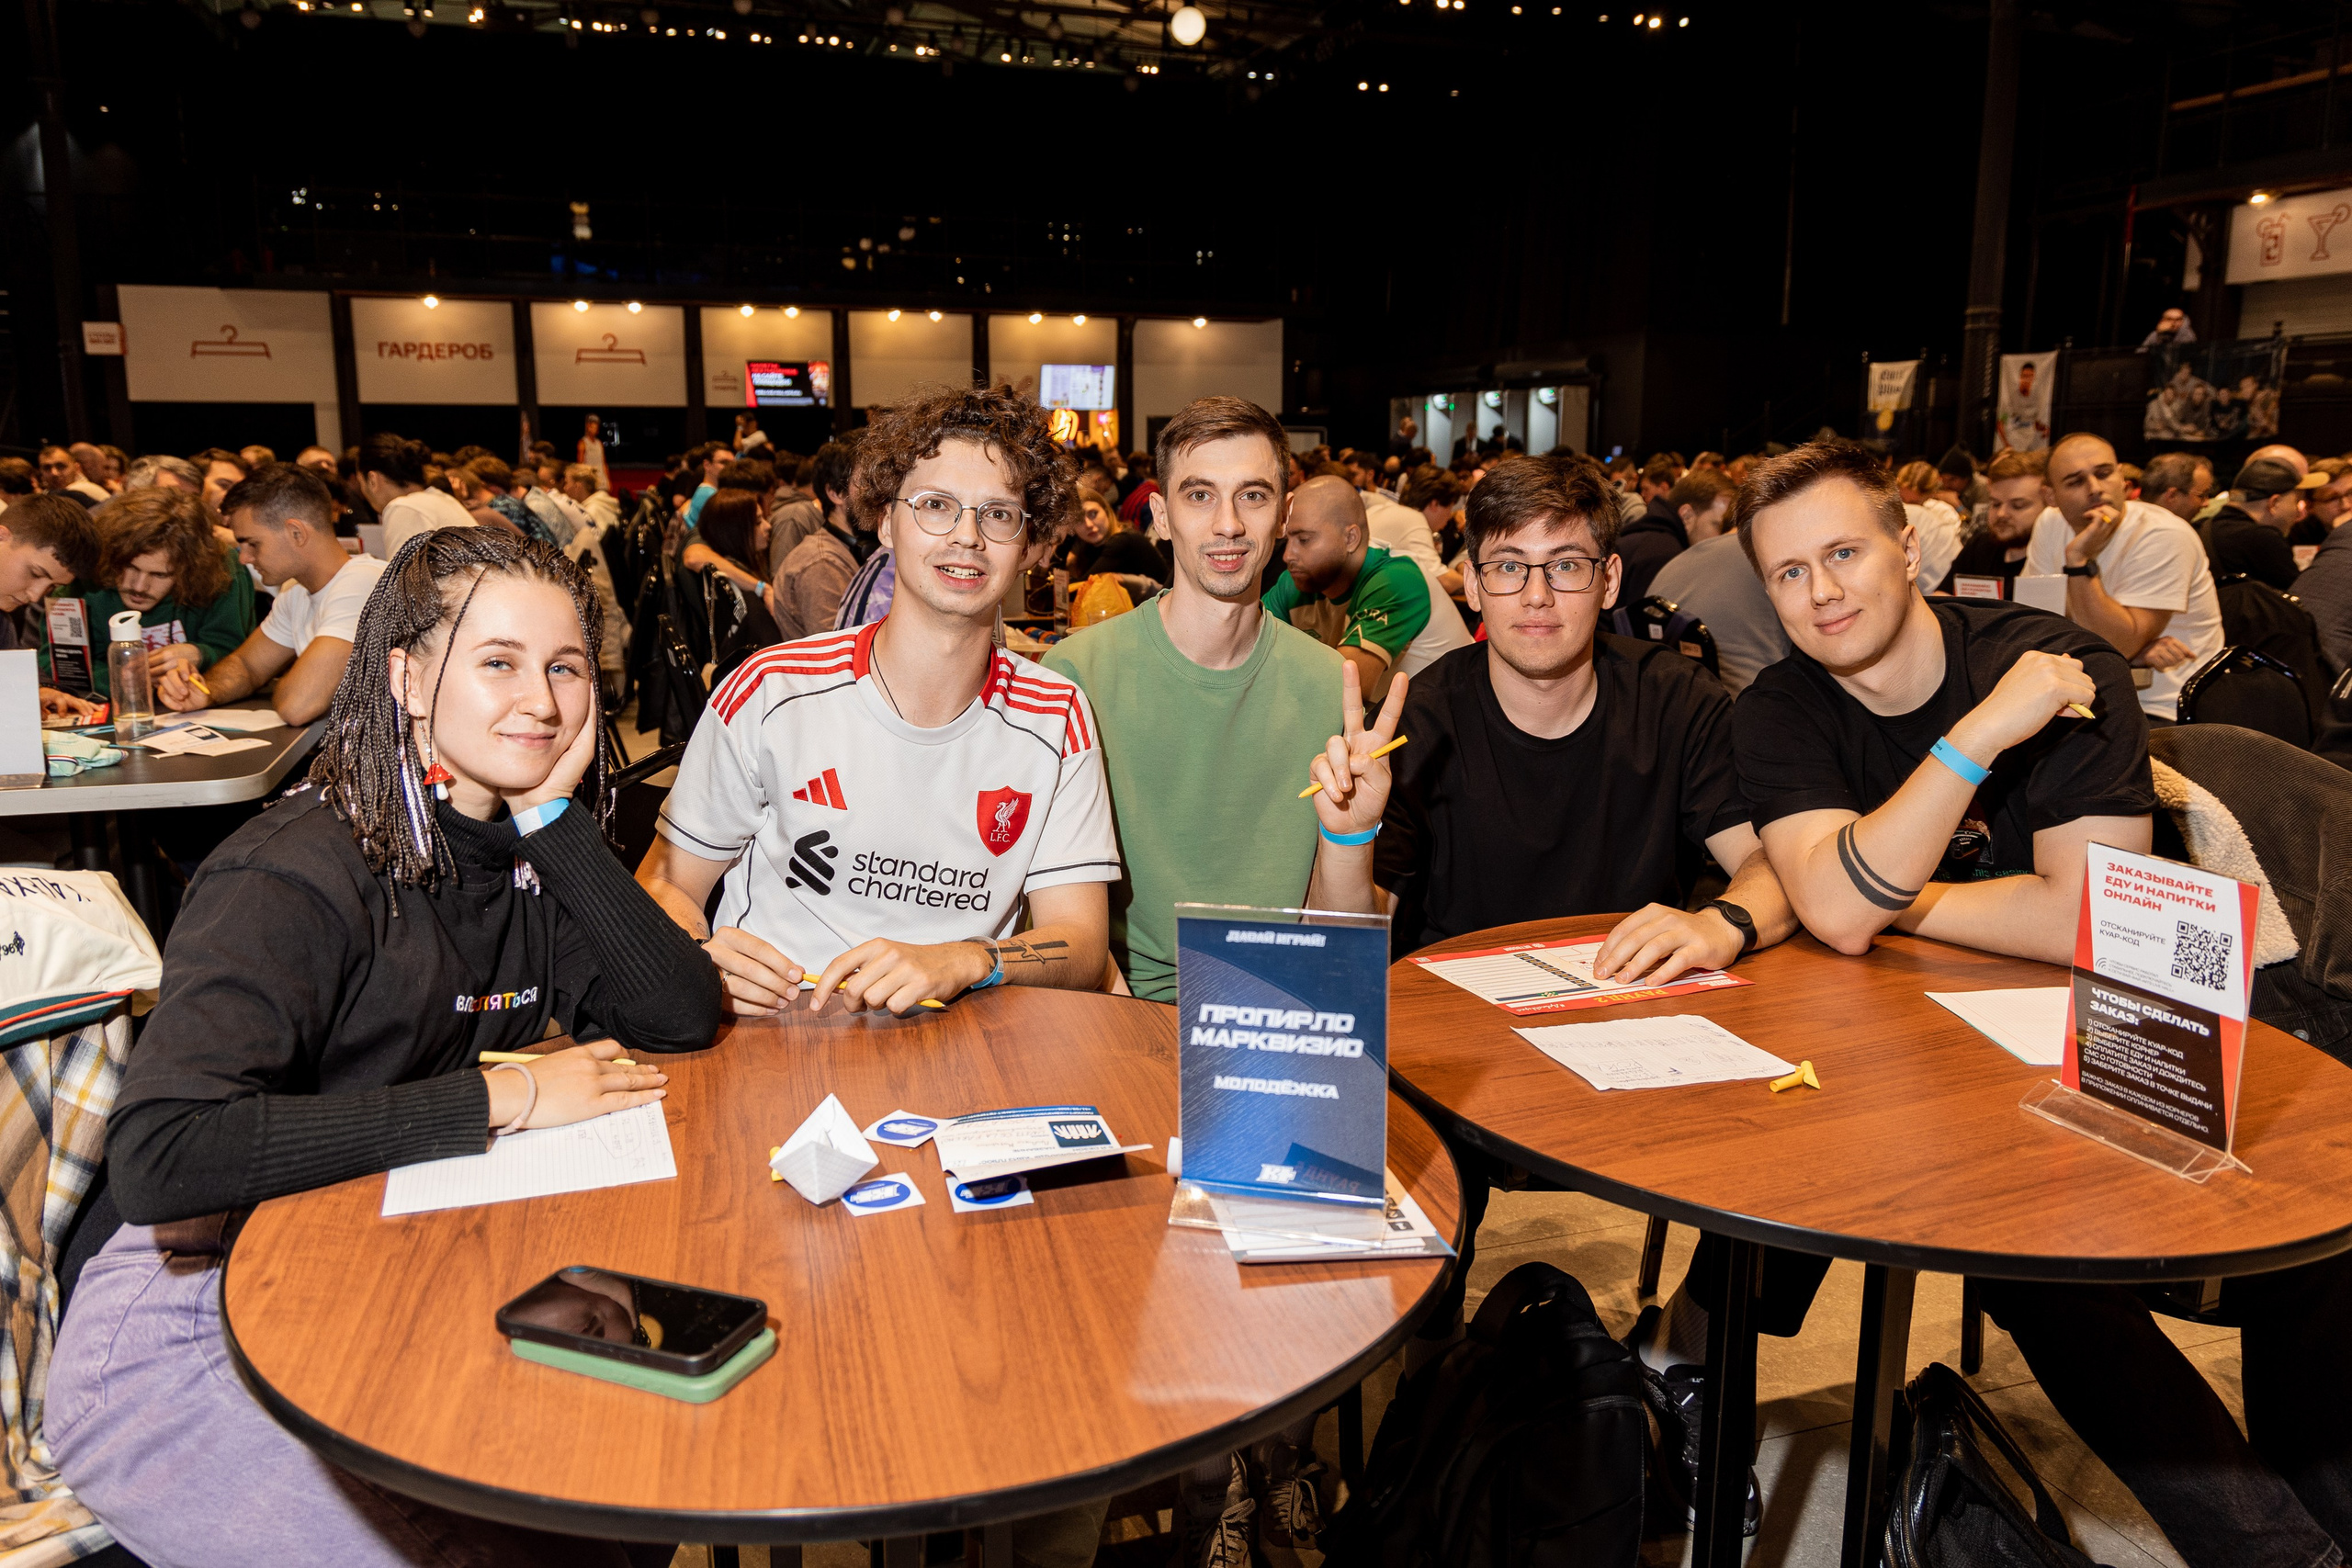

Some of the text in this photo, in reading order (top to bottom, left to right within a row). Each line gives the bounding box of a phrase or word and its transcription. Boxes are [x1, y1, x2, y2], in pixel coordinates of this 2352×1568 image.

[377, 341, 494, 362] ГАРДЕРОБ
[852, 851, 989, 888] standard
[2107, 863, 2213, 897] ЗАКАЗЫВАЙТЕ
[848, 875, 991, 912] chartered
[2103, 888, 2162, 912] ОНЛАЙН
[2105, 874, 2216, 913] ЕДУ И НАПИТКИ
[1226, 930, 1327, 948] ДАВАЙ ИГРАЙ!
[2099, 928, 2140, 947] КУАР-КОД
[2100, 919, 2166, 945] ОТСКАНИРУЙТЕ
[1198, 1003, 1355, 1033] ПРОПИРЛО
[2090, 1000, 2140, 1026] ЗАКАЗ:
[2091, 987, 2211, 1037] ЧТОБЫ СДЕЛАТЬ
[1190, 1026, 1364, 1058] МАРКВИЗИО
[2086, 1026, 2160, 1057] 2) ВЫБЕРИТЕ КОРНЕР
[2086, 1032, 2093, 1042] 3)
[2093, 1035, 2130, 1054] ВЫБЕРИТЕ
[2130, 1050, 2144, 1060] ЕДУ
[2151, 1056, 2186, 1076] НАПИТКИ
[2087, 1018, 2184, 1060] 1) ОТСКАНИРУЙТЕ КУАР-КОД
[2084, 1047, 2099, 1058] СМС
[2106, 1055, 2153, 1079] ГОТОВНОСТИ
[2092, 1043, 2128, 1062] ОПЛАТИТЕ
[2129, 1057, 2152, 1071] ЗАКАЗ
[2158, 1066, 2207, 1092] ДОЖДИТЕСЬ
[1213, 1075, 1340, 1100] МОЛОДЁЖКА
[2083, 1055, 2091, 1064] 5)
[2091, 1057, 2126, 1077] ЗАБЕРИТЕ
[2126, 1070, 2150, 1085] ЗАКАЗ
[2156, 1083, 2179, 1098] ТОЧКЕ
[2180, 1089, 2213, 1111] ВЫДАЧИ
[2086, 1078, 2127, 1100] ПРИЛОЖЕНИИ
[2126, 1095, 2174, 1119] ОПЛАЧИВАЕТСЯ
[2104, 1079, 2123, 1091] ЗАКАЗ
[2128, 1088, 2156, 1105] КАЖДОМ
[2156, 1100, 2165, 1108] ИЗ
[2165, 1102, 2199, 1122] КОРНЕРОВ
